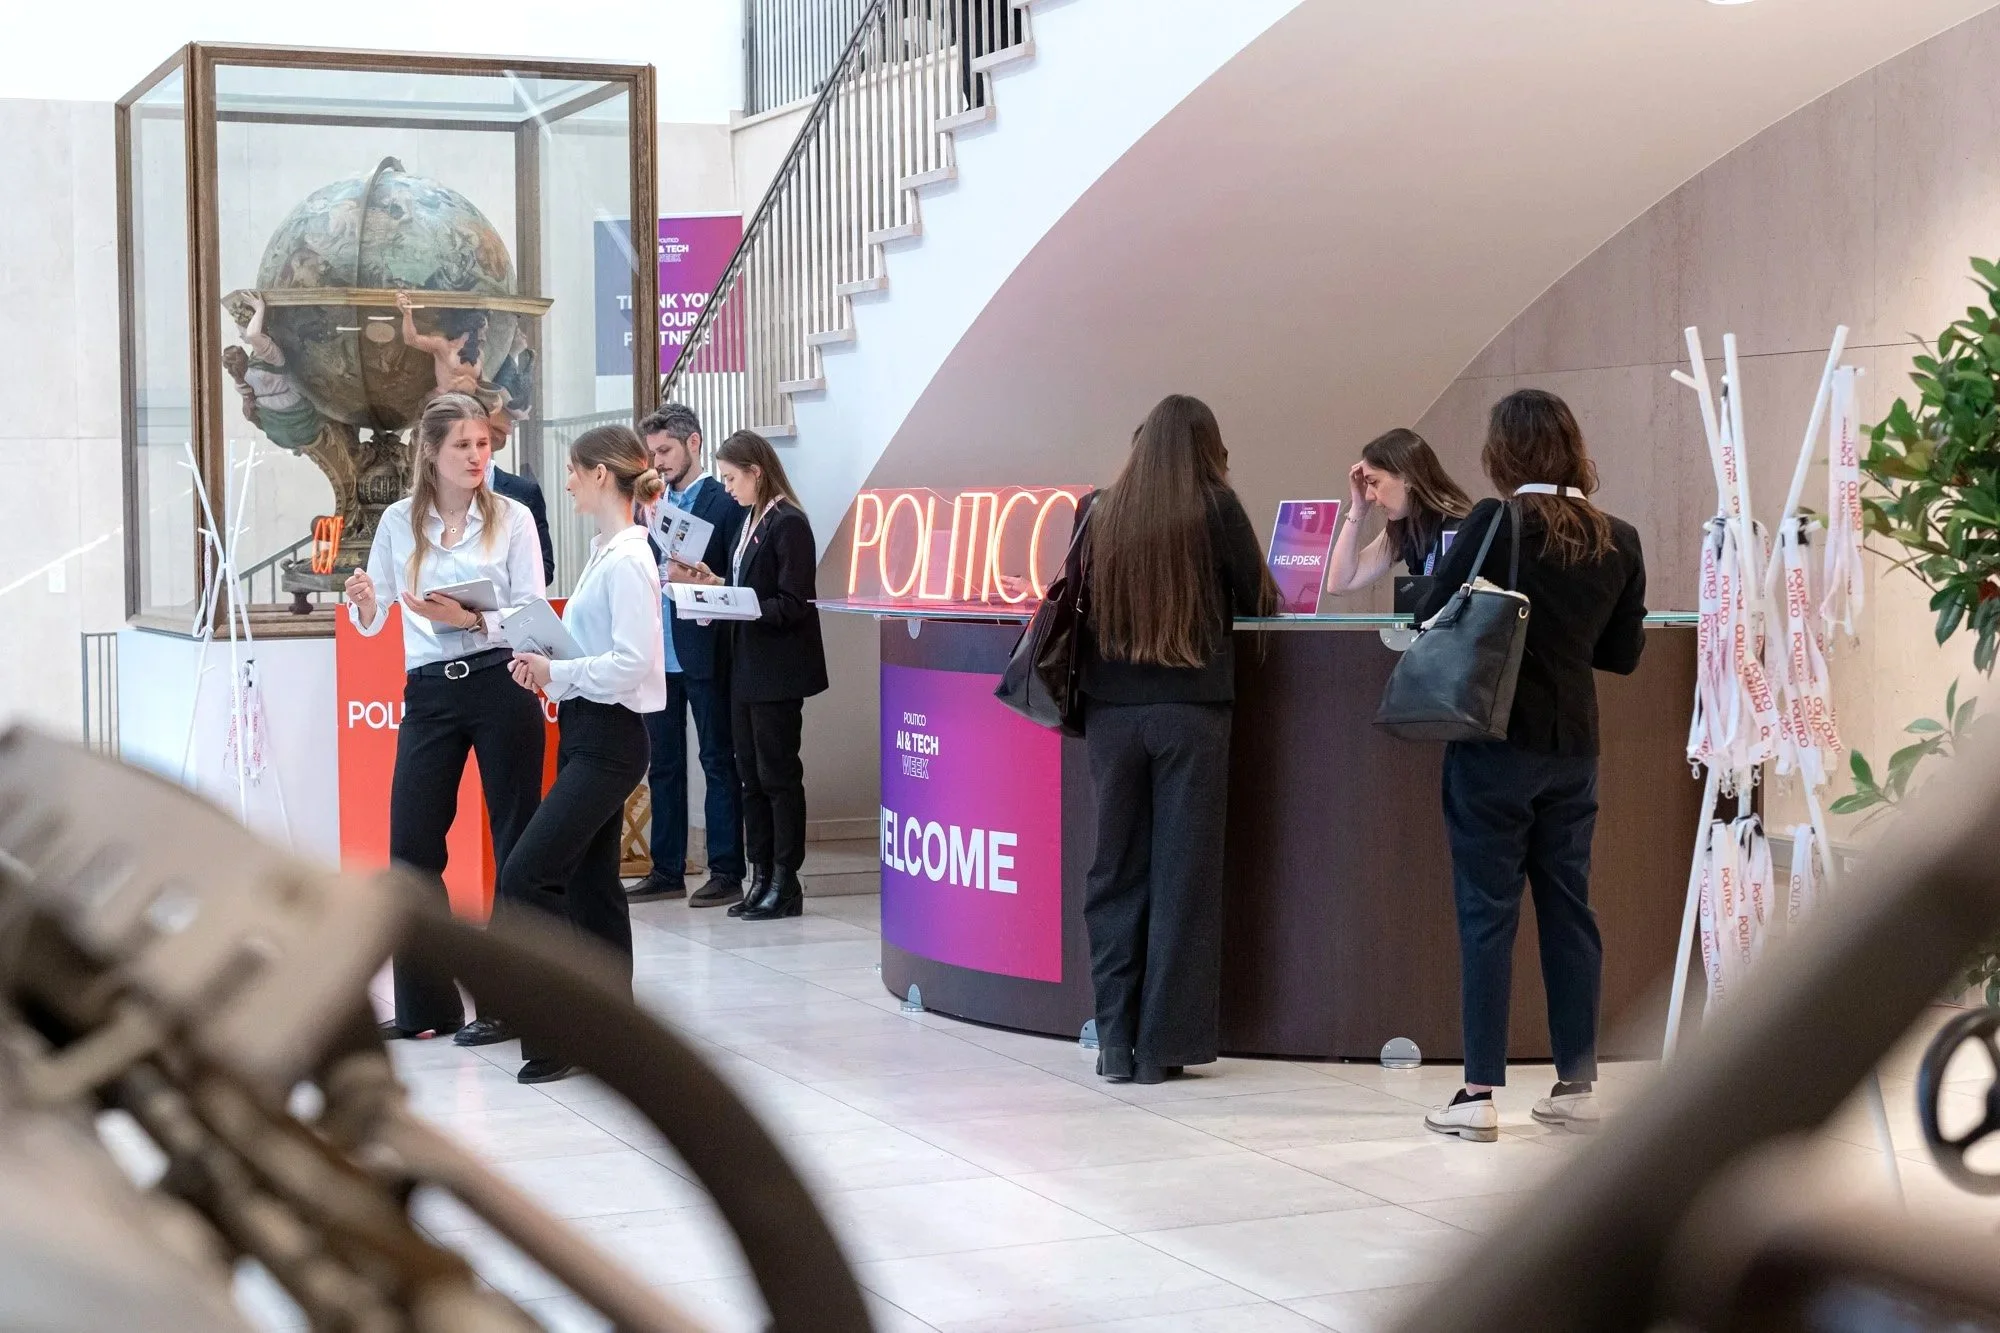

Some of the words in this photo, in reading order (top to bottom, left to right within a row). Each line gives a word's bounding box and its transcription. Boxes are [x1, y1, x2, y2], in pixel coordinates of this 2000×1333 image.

[665, 244, 689, 253] TECH
[616, 293, 678, 310] TNK
[661, 311, 699, 328] OUR
[1273, 554, 1321, 566] HELPDESK
[1720, 575, 1731, 626] POLITICO
[1748, 661, 1774, 711] POLITICO
[903, 711, 927, 727] POLITICO
[1791, 698, 1810, 748] POLITICO
[896, 729, 904, 750] AI
[904, 731, 912, 752] &
[911, 732, 939, 756] TECH
[901, 754, 929, 780] WEEK
[1721, 867, 1734, 917] POLITICO
[1738, 915, 1751, 965] POLITICO
